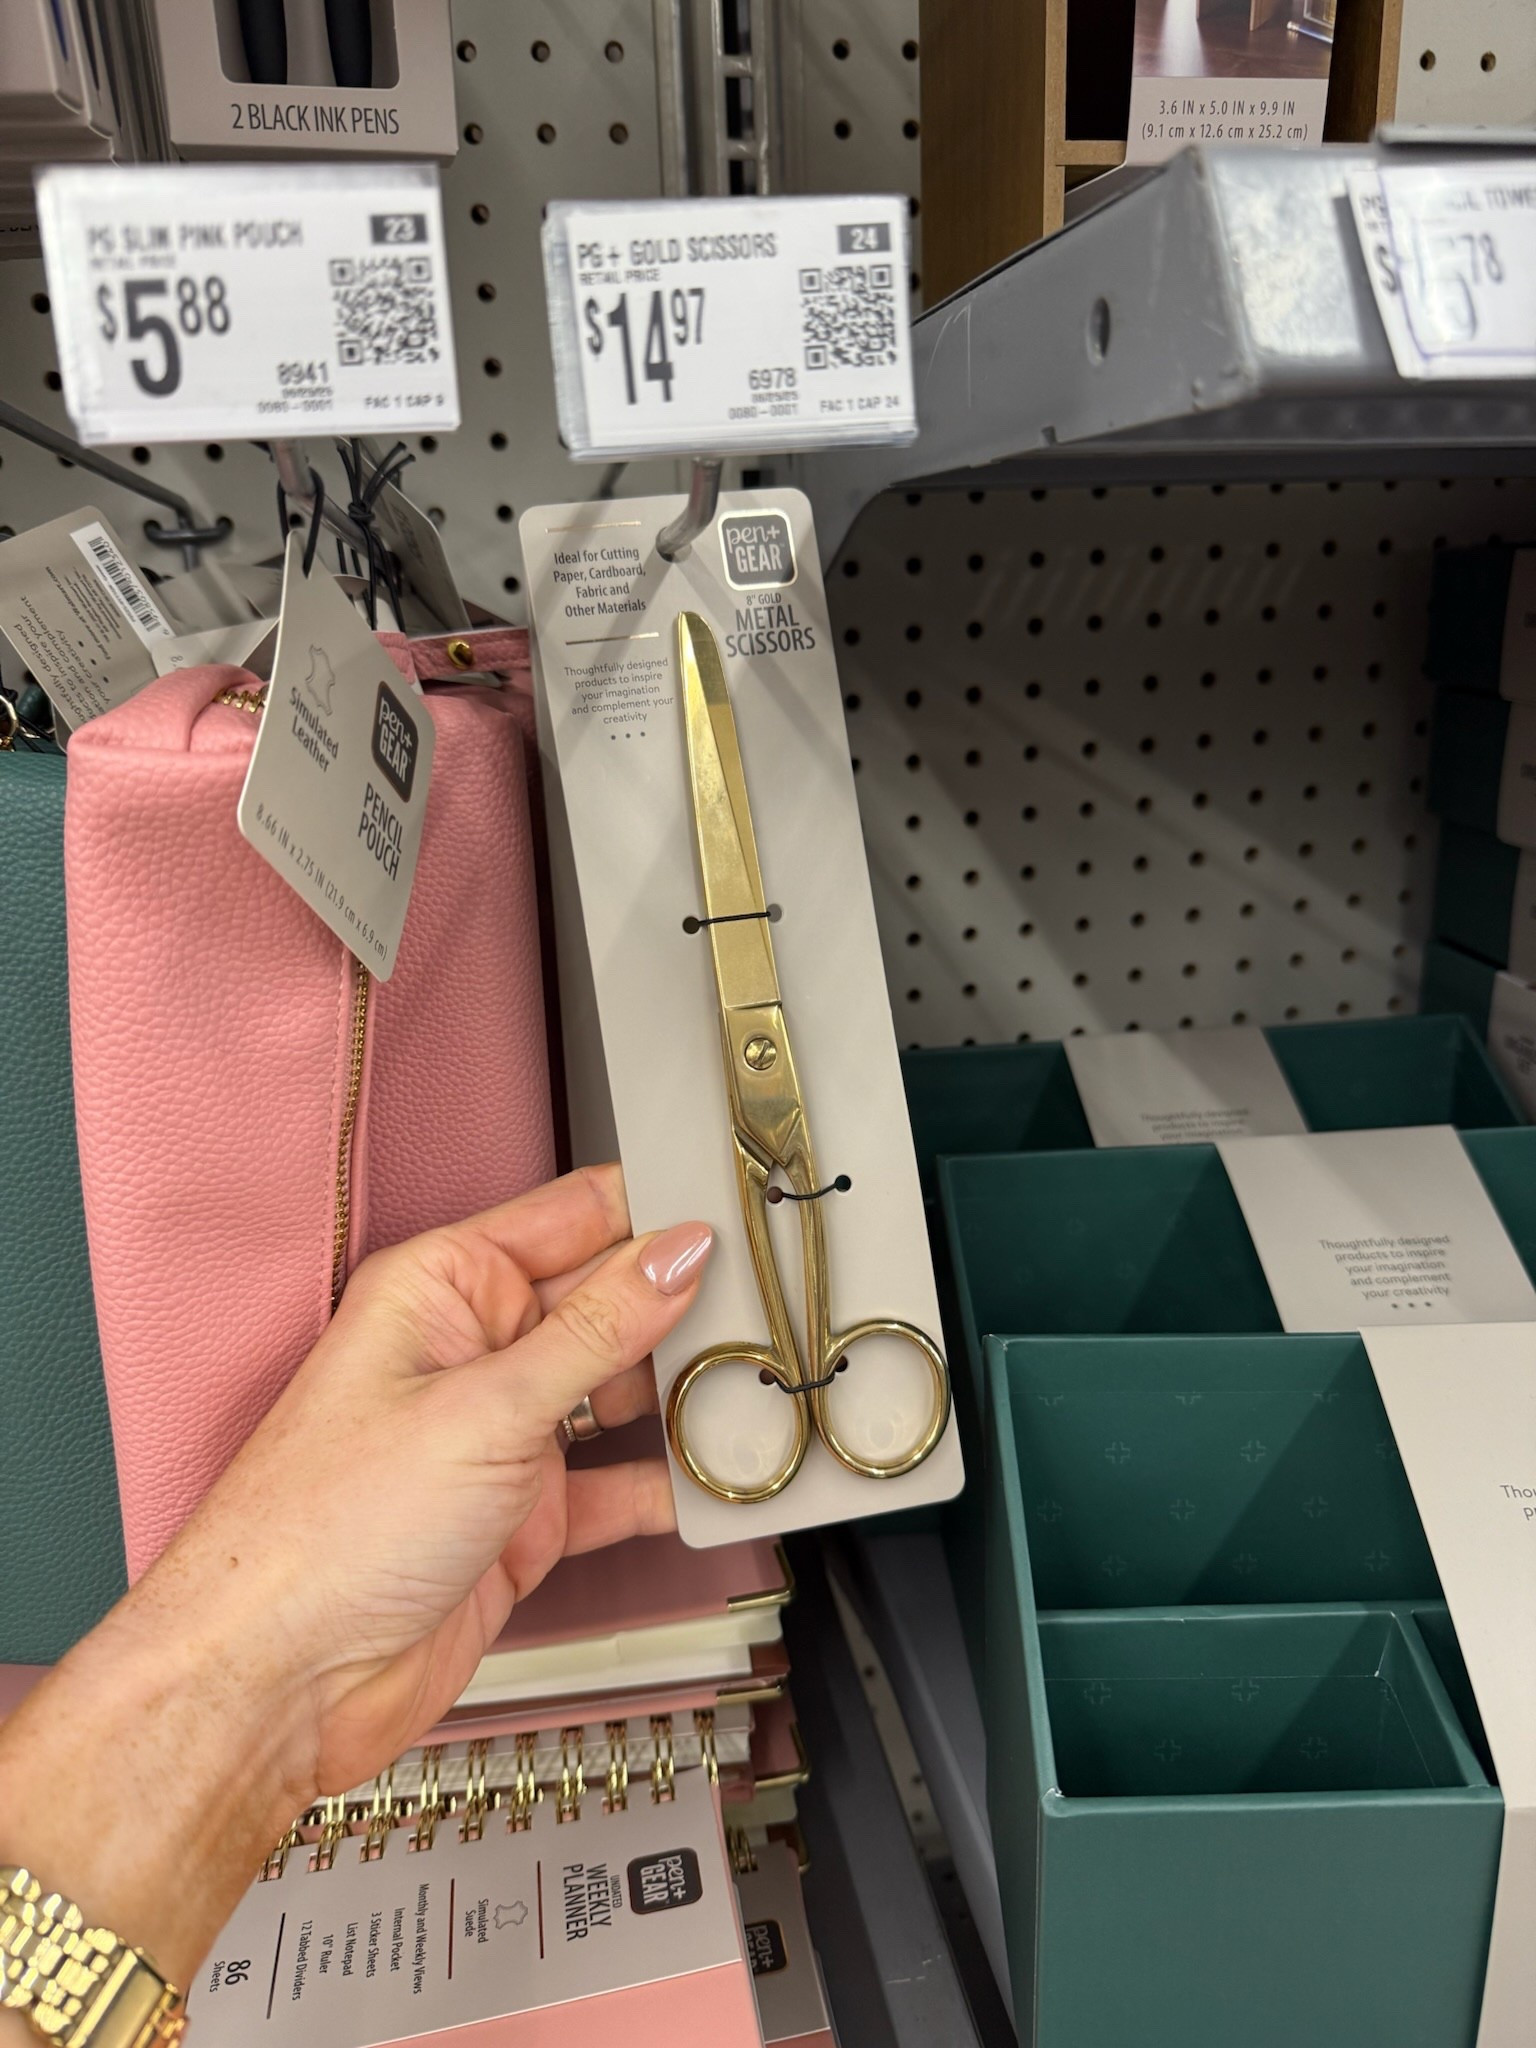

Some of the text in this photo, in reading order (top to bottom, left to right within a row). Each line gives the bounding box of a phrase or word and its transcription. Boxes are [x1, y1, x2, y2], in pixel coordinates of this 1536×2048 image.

[231, 103, 400, 135] 2 BLACK INK PENS
[1159, 100, 1295, 116] 3.6 IN x 5.0 IN x 9.9 IN
[1142, 123, 1308, 141] (9.1 cm x 12.6 cm x 25.2 cm)
[123, 224, 169, 251] SLIM
[179, 223, 226, 249] PINK
[233, 220, 303, 249] POUCH
[384, 217, 416, 242] 23
[851, 227, 879, 250] 24
[577, 242, 603, 268] PG
[630, 238, 681, 266] GOLD
[687, 231, 778, 263] SCISSORS
[625, 269, 662, 283] PRICE
[748, 366, 797, 391] 6978
[820, 396, 900, 413] FAC 1 CAP 24
[554, 547, 640, 565] Ideal for Cutting
[735, 543, 782, 574] GEAR
[553, 563, 646, 584] Paper, Cardboard,
[44, 565, 81, 616] Walmart.com
[575, 582, 631, 599] Fabric and
[758, 592, 782, 606] GOLD
[565, 599, 647, 618] Other Materials
[735, 603, 800, 632] METAL
[19, 594, 85, 686] and complement
[20, 612, 43, 640] your
[13, 623, 52, 674] designed
[54, 628, 93, 680] creativity
[725, 627, 816, 658] SCISSORS
[38, 639, 69, 678] inspire
[564, 657, 669, 677] Thoughtfully designed
[64, 677, 77, 692] to
[90, 678, 112, 705] your
[574, 672, 663, 690] products to inspire
[581, 685, 660, 703] your imagination
[571, 697, 674, 716] and complement your
[603, 711, 648, 725] creativity
[289, 686, 340, 760] Simulated
[292, 715, 331, 773] Leather
[379, 724, 409, 783] GEAR
[363, 782, 403, 854] PENCIL
[358, 811, 400, 882] POUCH
[256, 802, 388, 961] 8.66 IN x 2.75 IN (21.9 cm x 6.9 cm)
[1318, 1235, 1450, 1251] Thoughtfully designed
[1334, 1248, 1446, 1263] products to inspire
[1344, 1260, 1446, 1275] your imagination
[1351, 1273, 1451, 1286] and complement
[1361, 1286, 1449, 1300] your creativity
[586, 1863, 612, 1926] WEEKLY
[610, 1874, 622, 1909] UNDATED
[640, 1863, 670, 1905] GEAR
[563, 1863, 588, 1942] PLANNER
[368, 1918, 381, 1946] Sticker
[465, 1909, 476, 1937] Suede
[477, 1898, 489, 1943] Simulated
[341, 1921, 358, 1976] List Notepad
[390, 1907, 406, 1972] Internal Pocket
[412, 1883, 429, 1994] Monthly and Weekly Views
[292, 1920, 313, 2001] 12 Tabbed Dividers
[319, 1934, 334, 1974] 10" Ruler
[366, 1947, 379, 1978] Sheets
[209, 1960, 225, 1993] Sheets
[225, 1959, 251, 1986] 86
